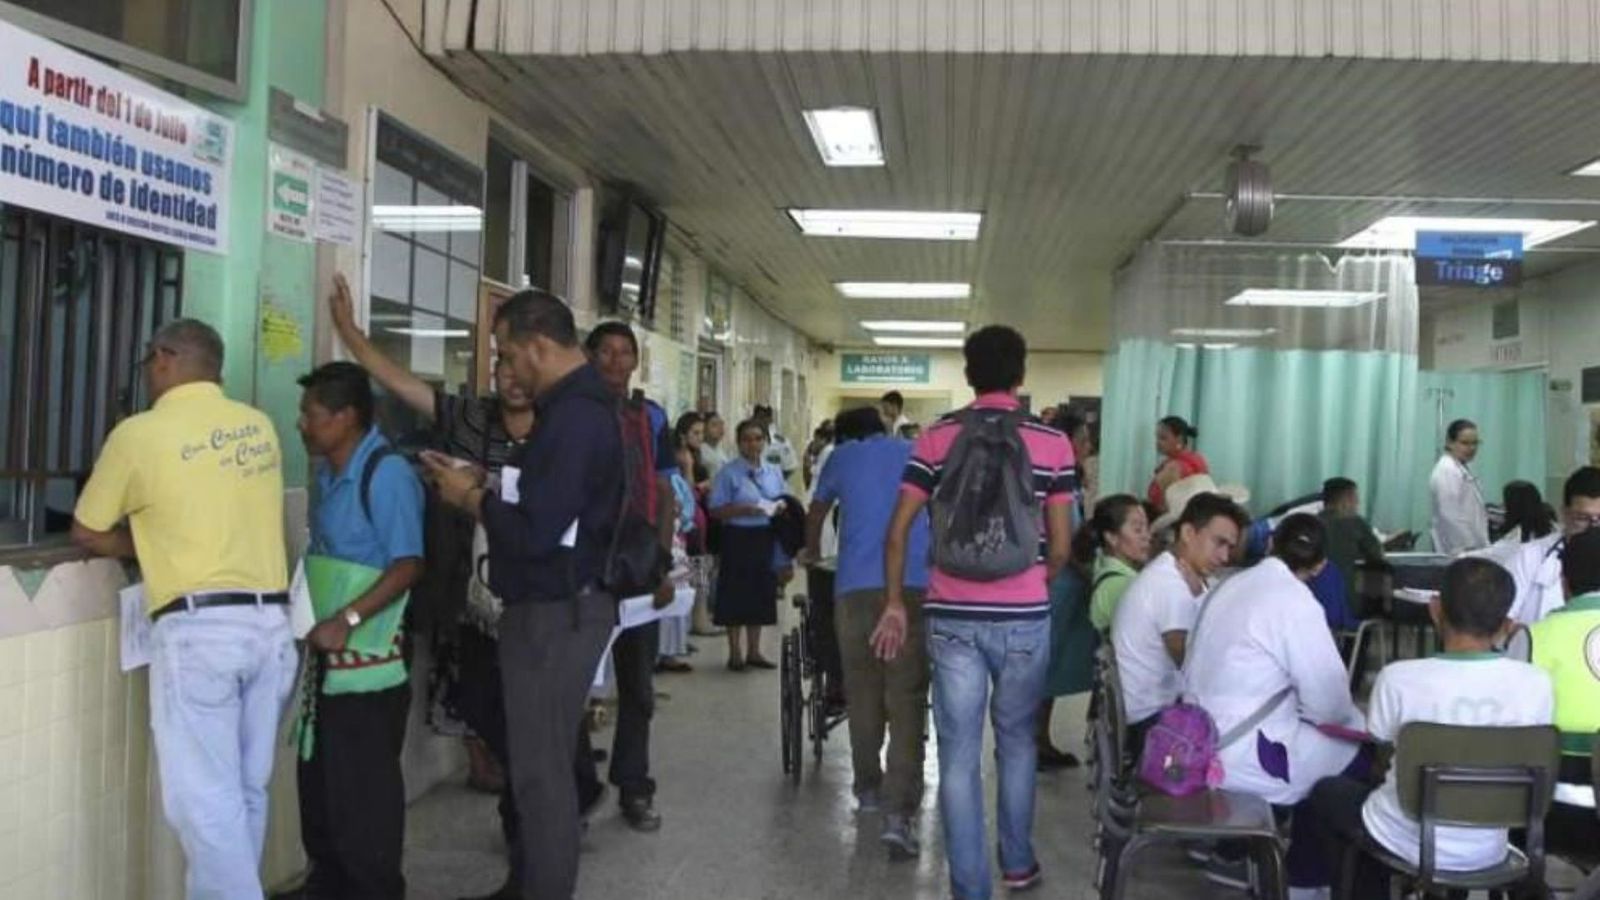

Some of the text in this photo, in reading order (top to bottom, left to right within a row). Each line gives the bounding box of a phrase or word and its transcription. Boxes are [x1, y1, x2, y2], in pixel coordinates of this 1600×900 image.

[27, 56, 40, 89] A
[44, 67, 94, 108] partir
[96, 86, 122, 120] del
[134, 102, 153, 132] de
[1, 143, 94, 196] número
[99, 171, 125, 205] de
[46, 112, 137, 171] también
[141, 150, 212, 195] usamos
[1436, 260, 1503, 284] Triage
[846, 364, 923, 374] LABORATORIO
